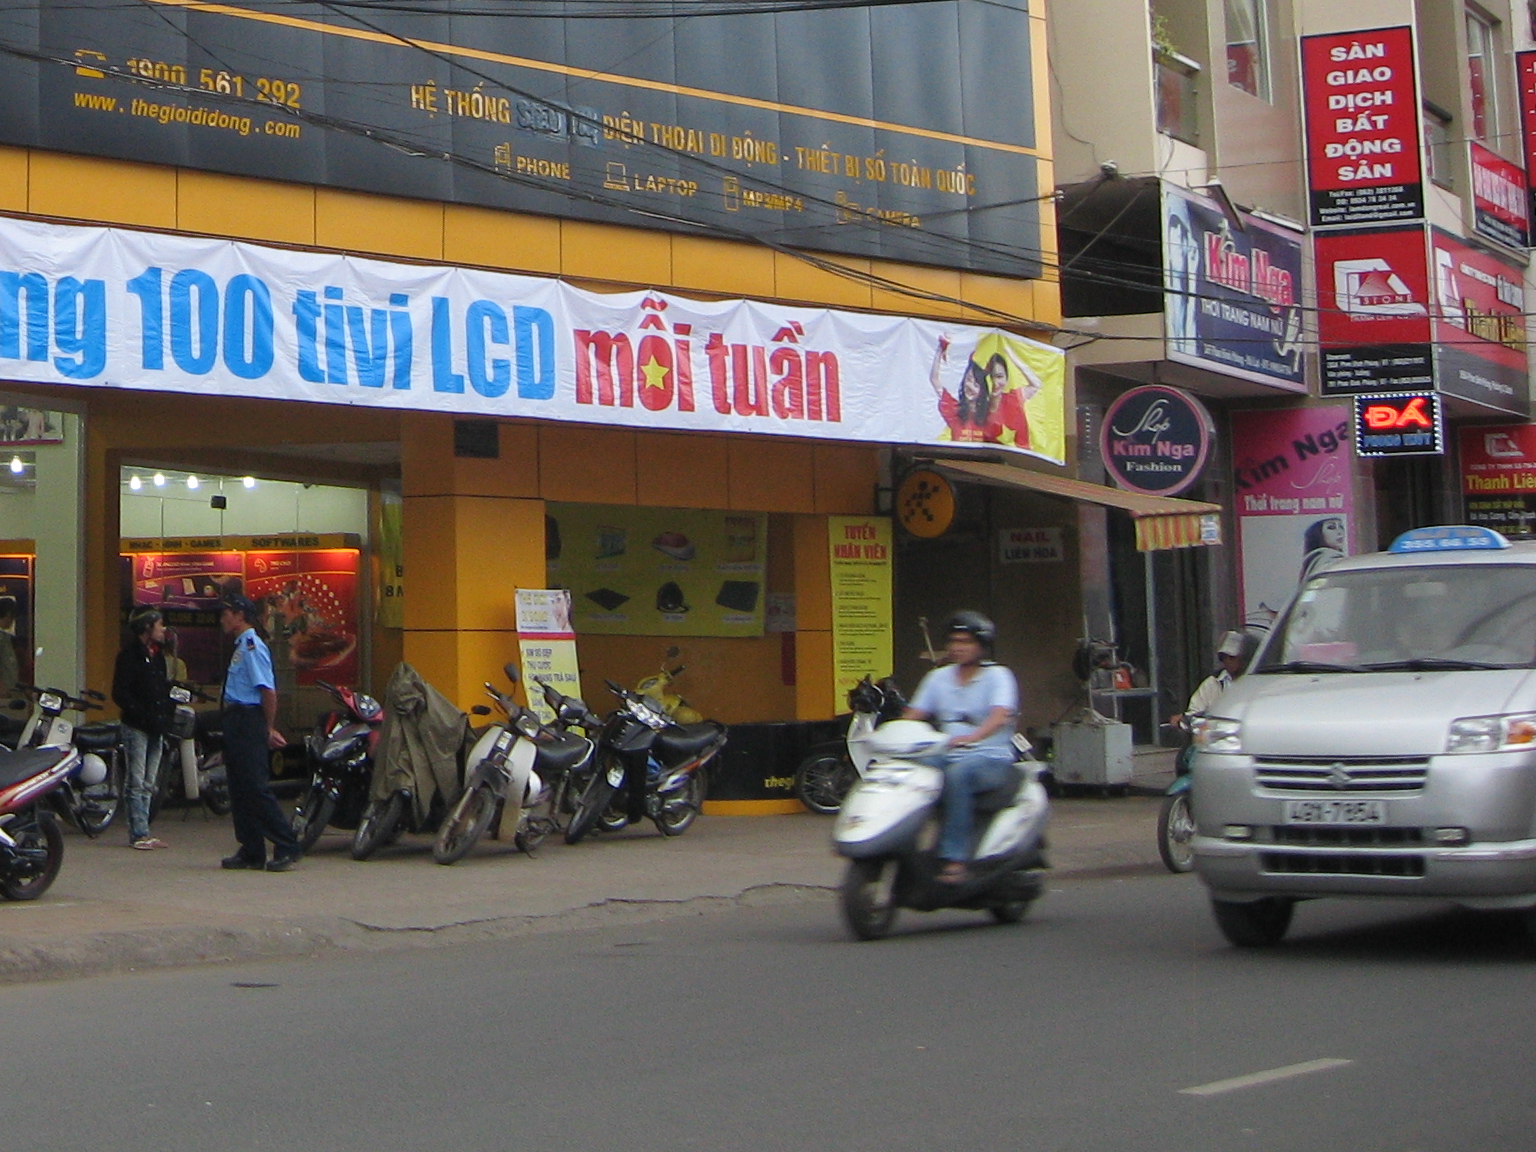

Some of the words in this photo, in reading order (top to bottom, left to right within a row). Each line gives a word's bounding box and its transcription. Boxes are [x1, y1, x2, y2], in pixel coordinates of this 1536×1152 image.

[1330, 42, 1385, 62] SÀN
[1326, 66, 1392, 86] GIAO
[200, 68, 244, 97] 561
[256, 78, 302, 109] 292
[1328, 90, 1393, 112] DỊCH
[1335, 110, 1389, 134] BẤT
[411, 79, 438, 119] HỆ
[444, 81, 512, 124] THỐNG
[731, 129, 779, 168] ĐỘNG
[794, 141, 841, 175] THIẾT
[845, 154, 861, 185] BỊ
[866, 148, 886, 182] SỐ
[891, 158, 932, 189] TOÀN
[937, 162, 977, 196] QUỐC
[1325, 138, 1402, 160] ĐỘNG
[516, 156, 572, 181] PHONE
[634, 173, 699, 197] LAPTOP
[1337, 161, 1393, 181] SẢN
[1221, 302, 1250, 326] TRANG
[1251, 312, 1270, 332] NAM
[126, 265, 272, 381] 100
[291, 285, 412, 391] tivi
[431, 295, 557, 402] LCD
[572, 299, 695, 412] mỗi
[707, 320, 841, 423] tuần
[1365, 397, 1431, 429] ĐÁ
[1114, 440, 1152, 457] Kim
[1157, 440, 1195, 460] Nga
[1126, 462, 1183, 472] Fashion
[1466, 474, 1509, 490] Thanh
[1271, 495, 1300, 514] trang
[251, 536, 320, 547] SOFTWARES
